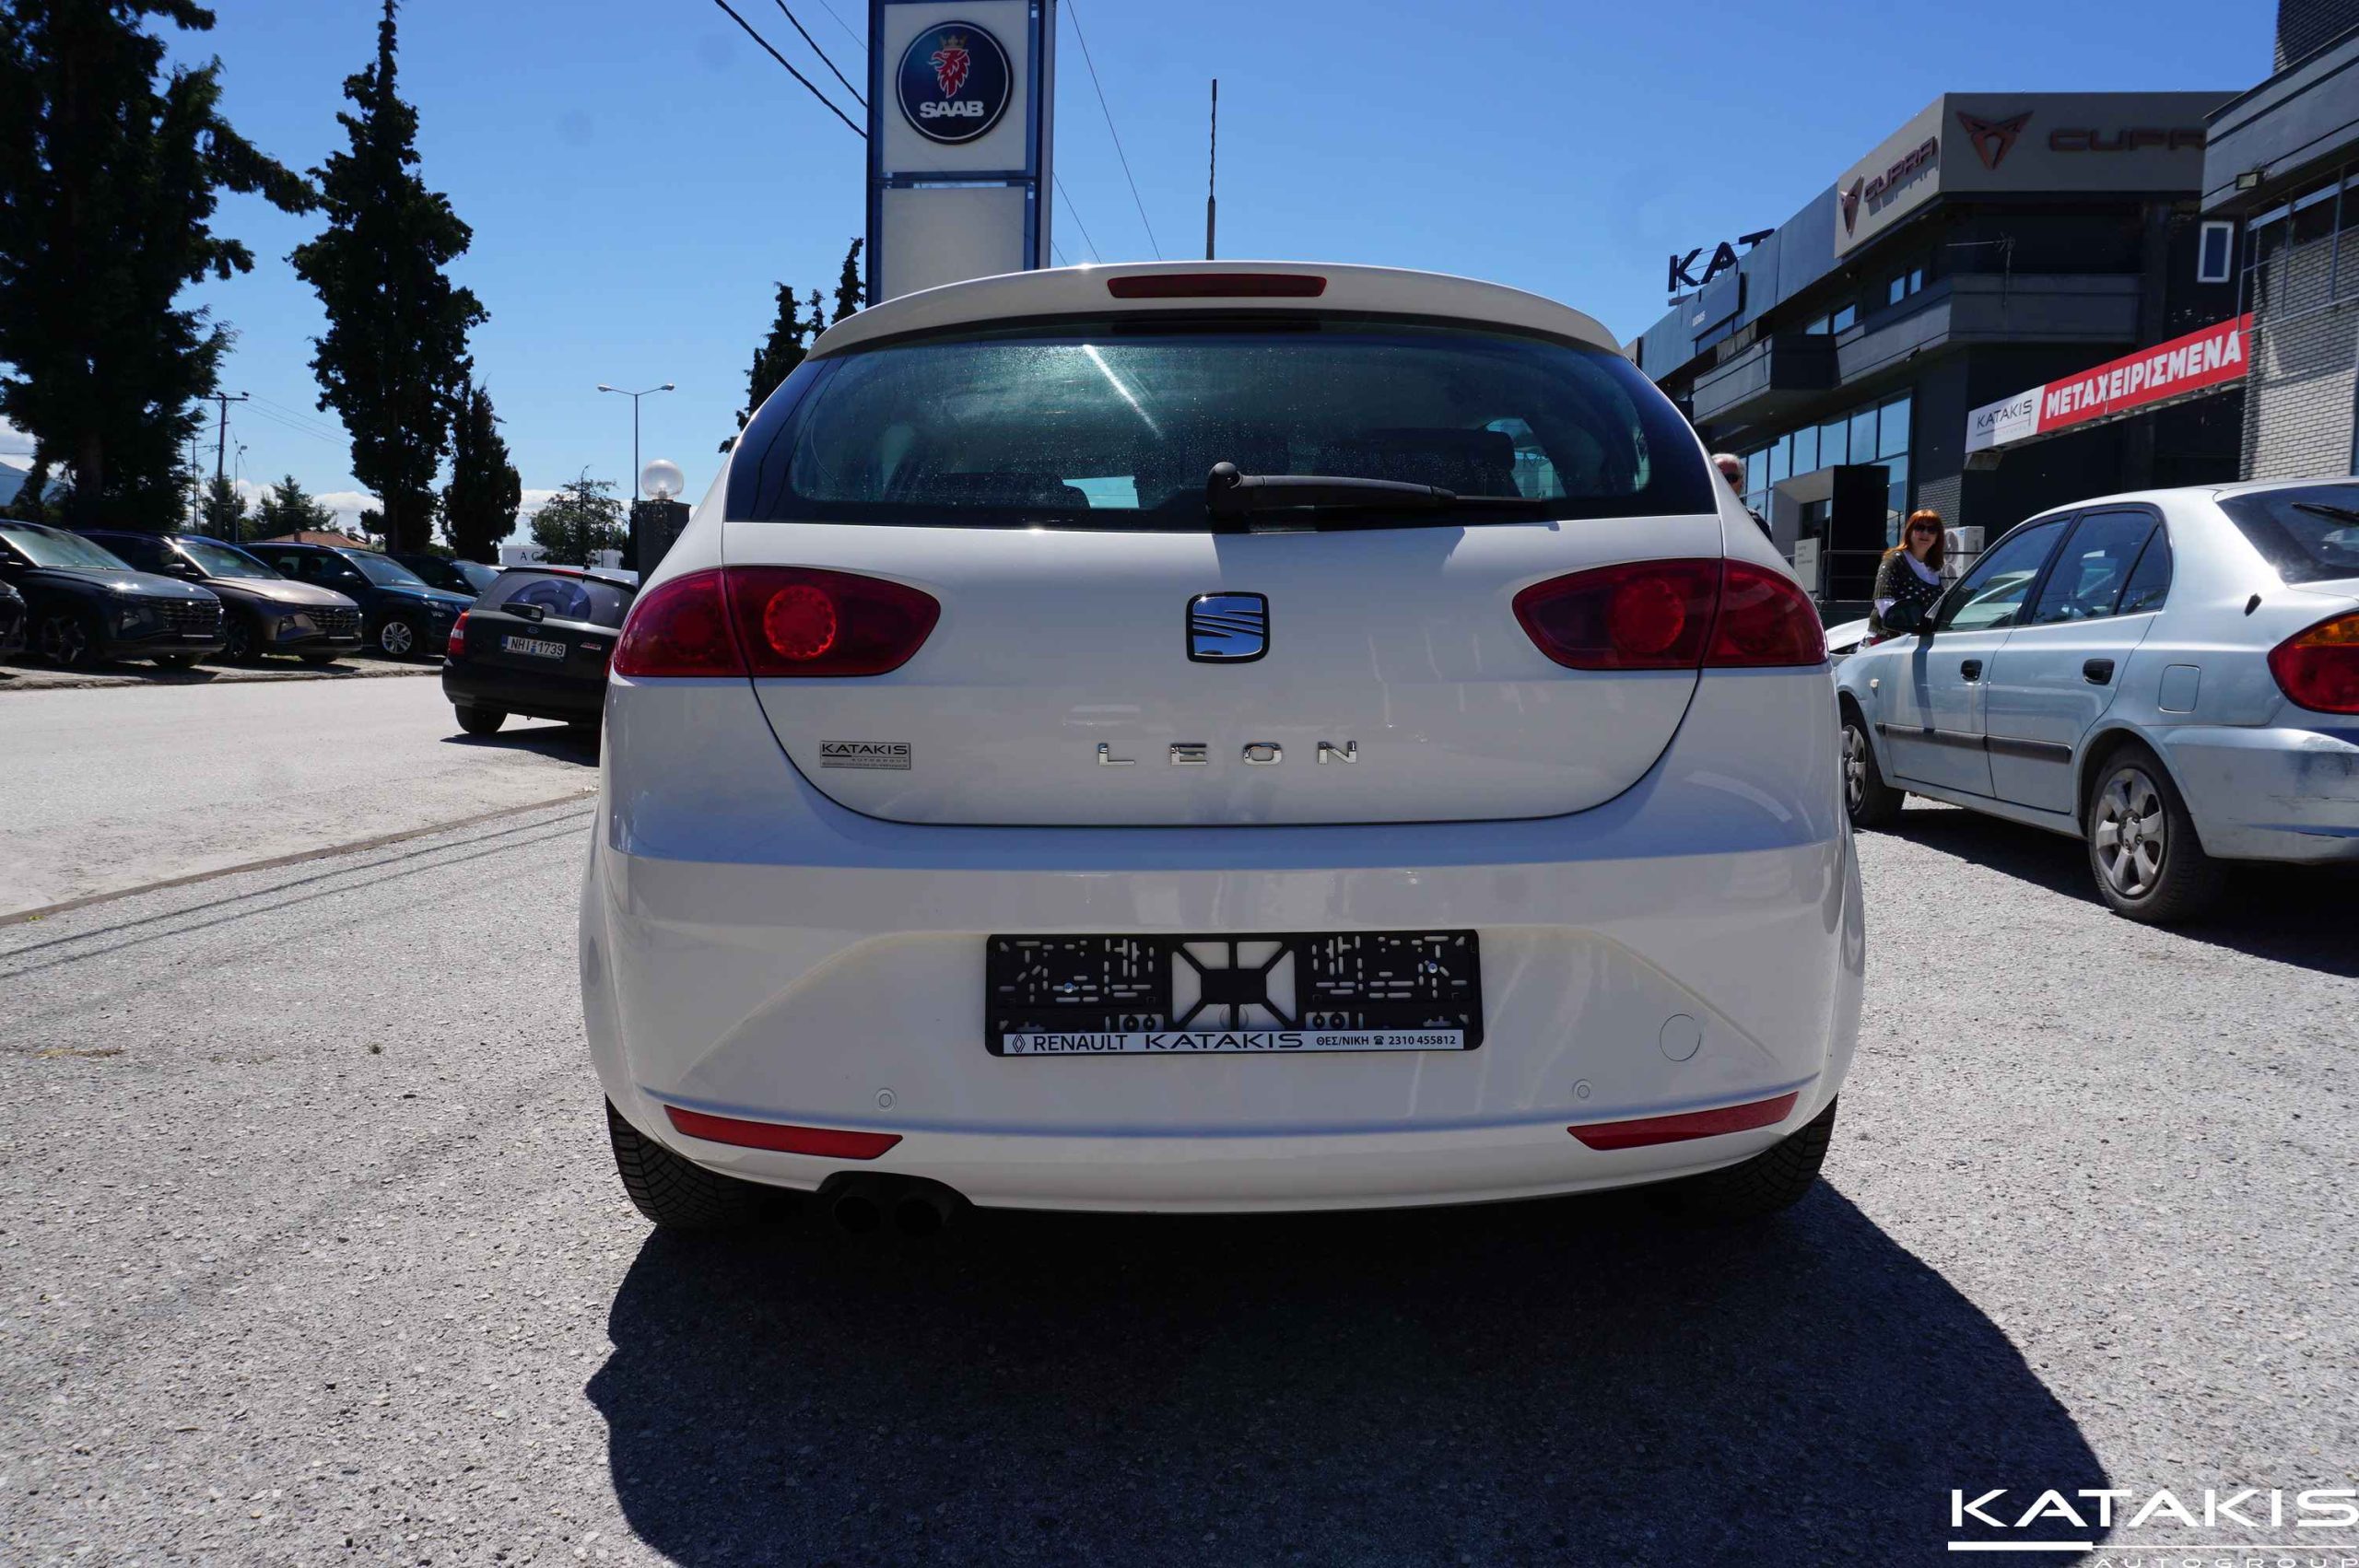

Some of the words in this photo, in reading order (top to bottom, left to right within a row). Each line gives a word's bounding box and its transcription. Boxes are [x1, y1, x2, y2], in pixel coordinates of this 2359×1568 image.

[920, 100, 985, 118] SAAB
[2049, 128, 2207, 152] CUPR
[1863, 135, 1935, 204] CUPRA
[2046, 330, 2242, 419] ΜΕΤΑΧΕΙΡΙΣΜΕΝΑ
[1977, 399, 2033, 429] KATAKIS
[538, 642, 564, 656] 1739
[822, 743, 908, 755] KATAKIS
[1097, 741, 1357, 766] LEON
[1033, 1035, 1128, 1051] RENAULT
[1145, 1033, 1303, 1049] KATAKIS
[1316, 1036, 1369, 1047] ΘΕΣ/ΝΙΚΗ
[1389, 1036, 1414, 1046] 2310
[1416, 1035, 1457, 1046] 455812
